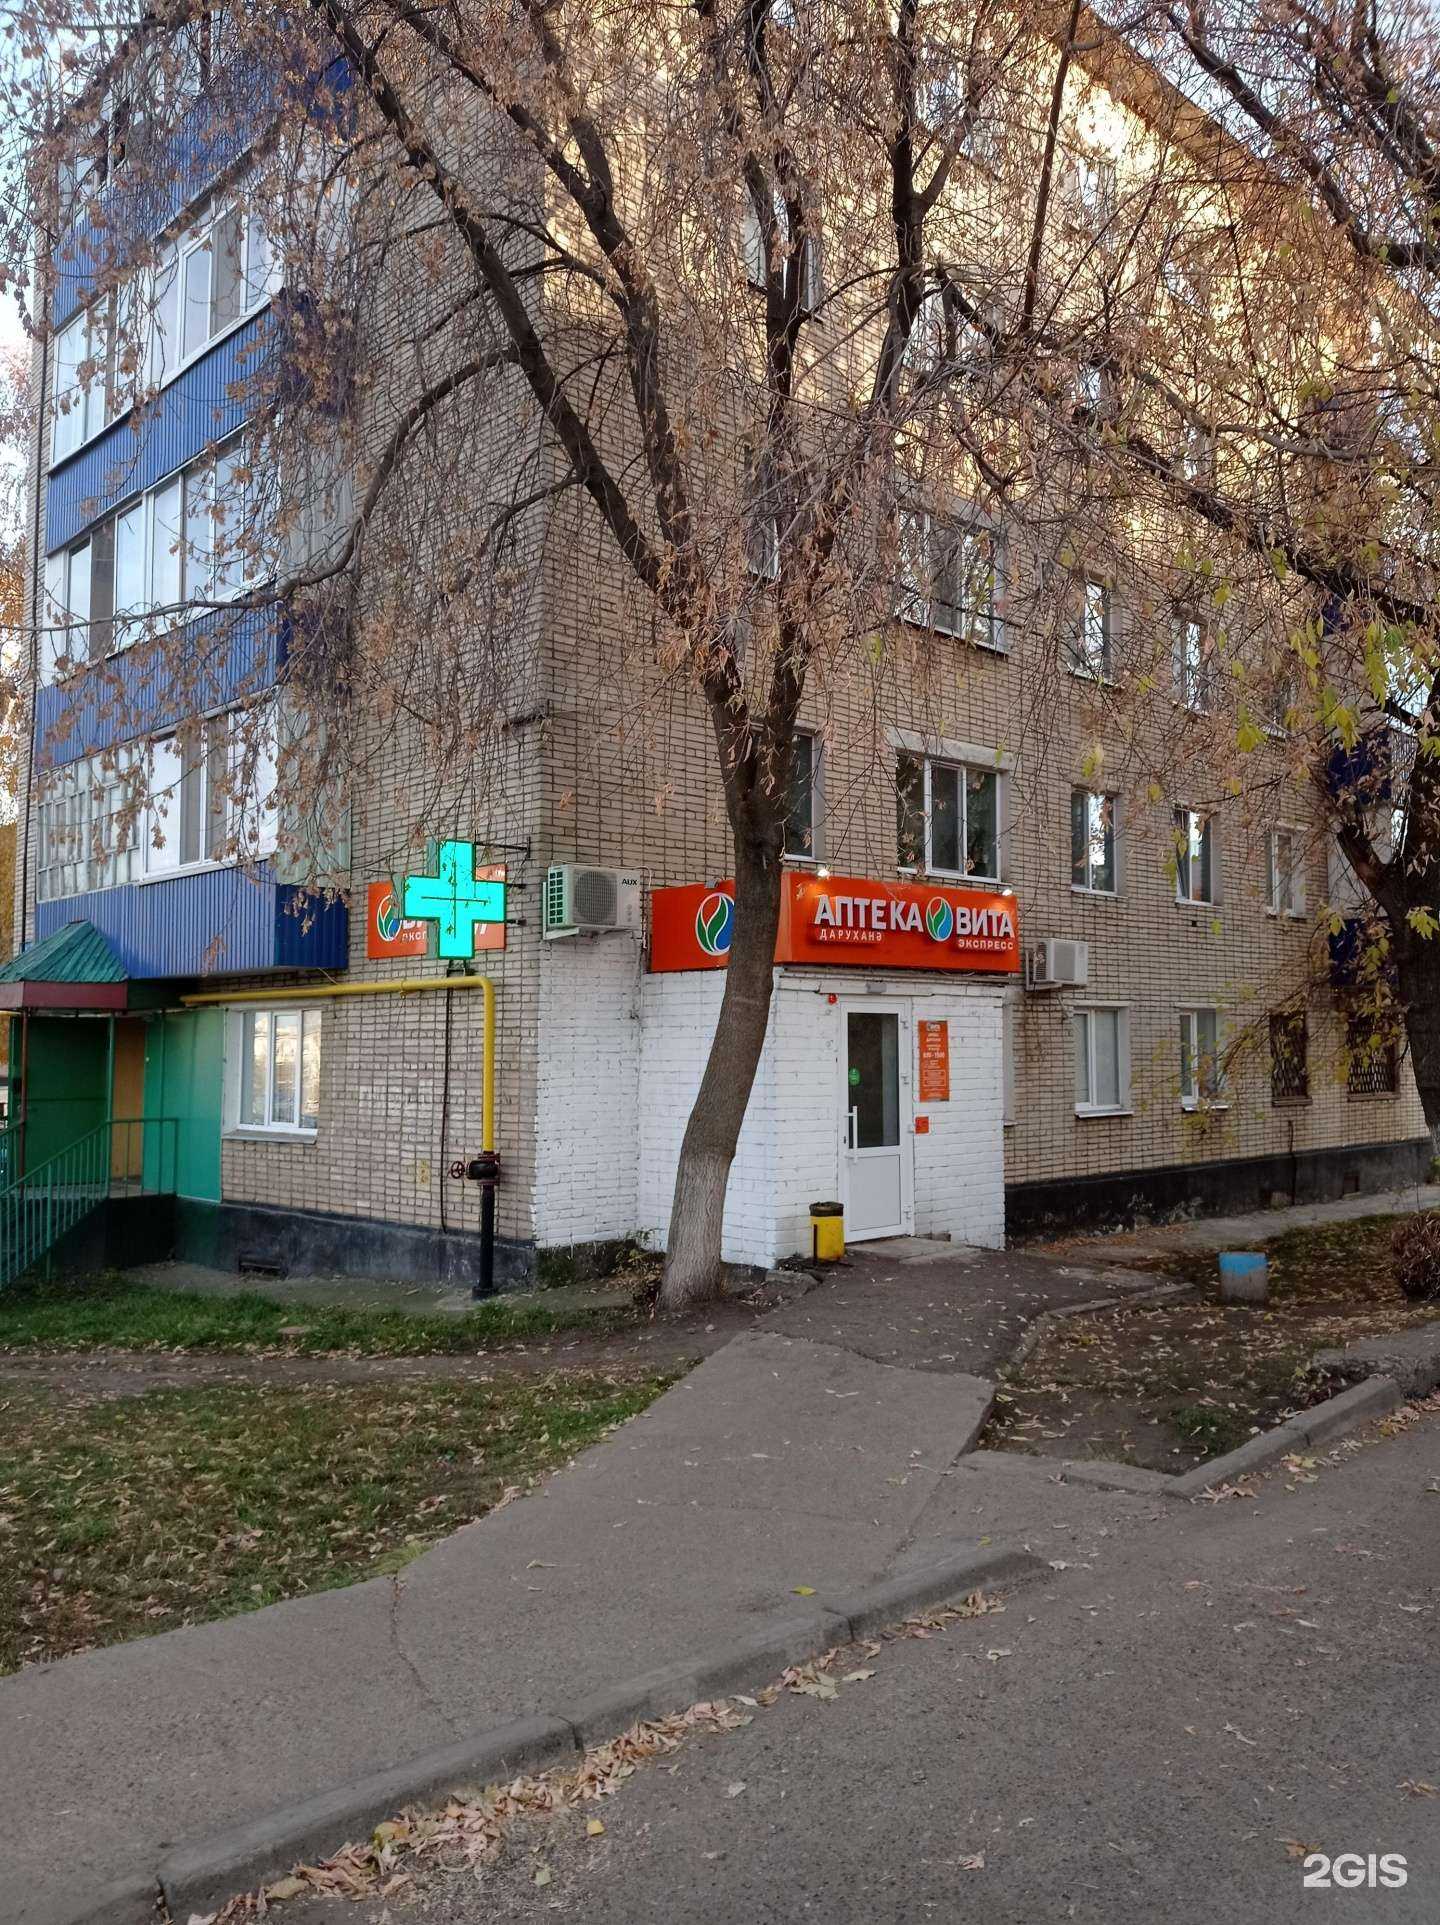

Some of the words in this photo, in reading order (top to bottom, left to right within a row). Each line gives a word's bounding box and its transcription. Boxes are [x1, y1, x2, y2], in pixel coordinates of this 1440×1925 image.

[621, 877, 638, 886] AUX
[813, 895, 924, 933] АПТЕКА
[957, 906, 1015, 938] ВИТА
[819, 928, 883, 942] ДАРУХАНӘ
[958, 938, 1014, 951] ЭКСПРЕСС
